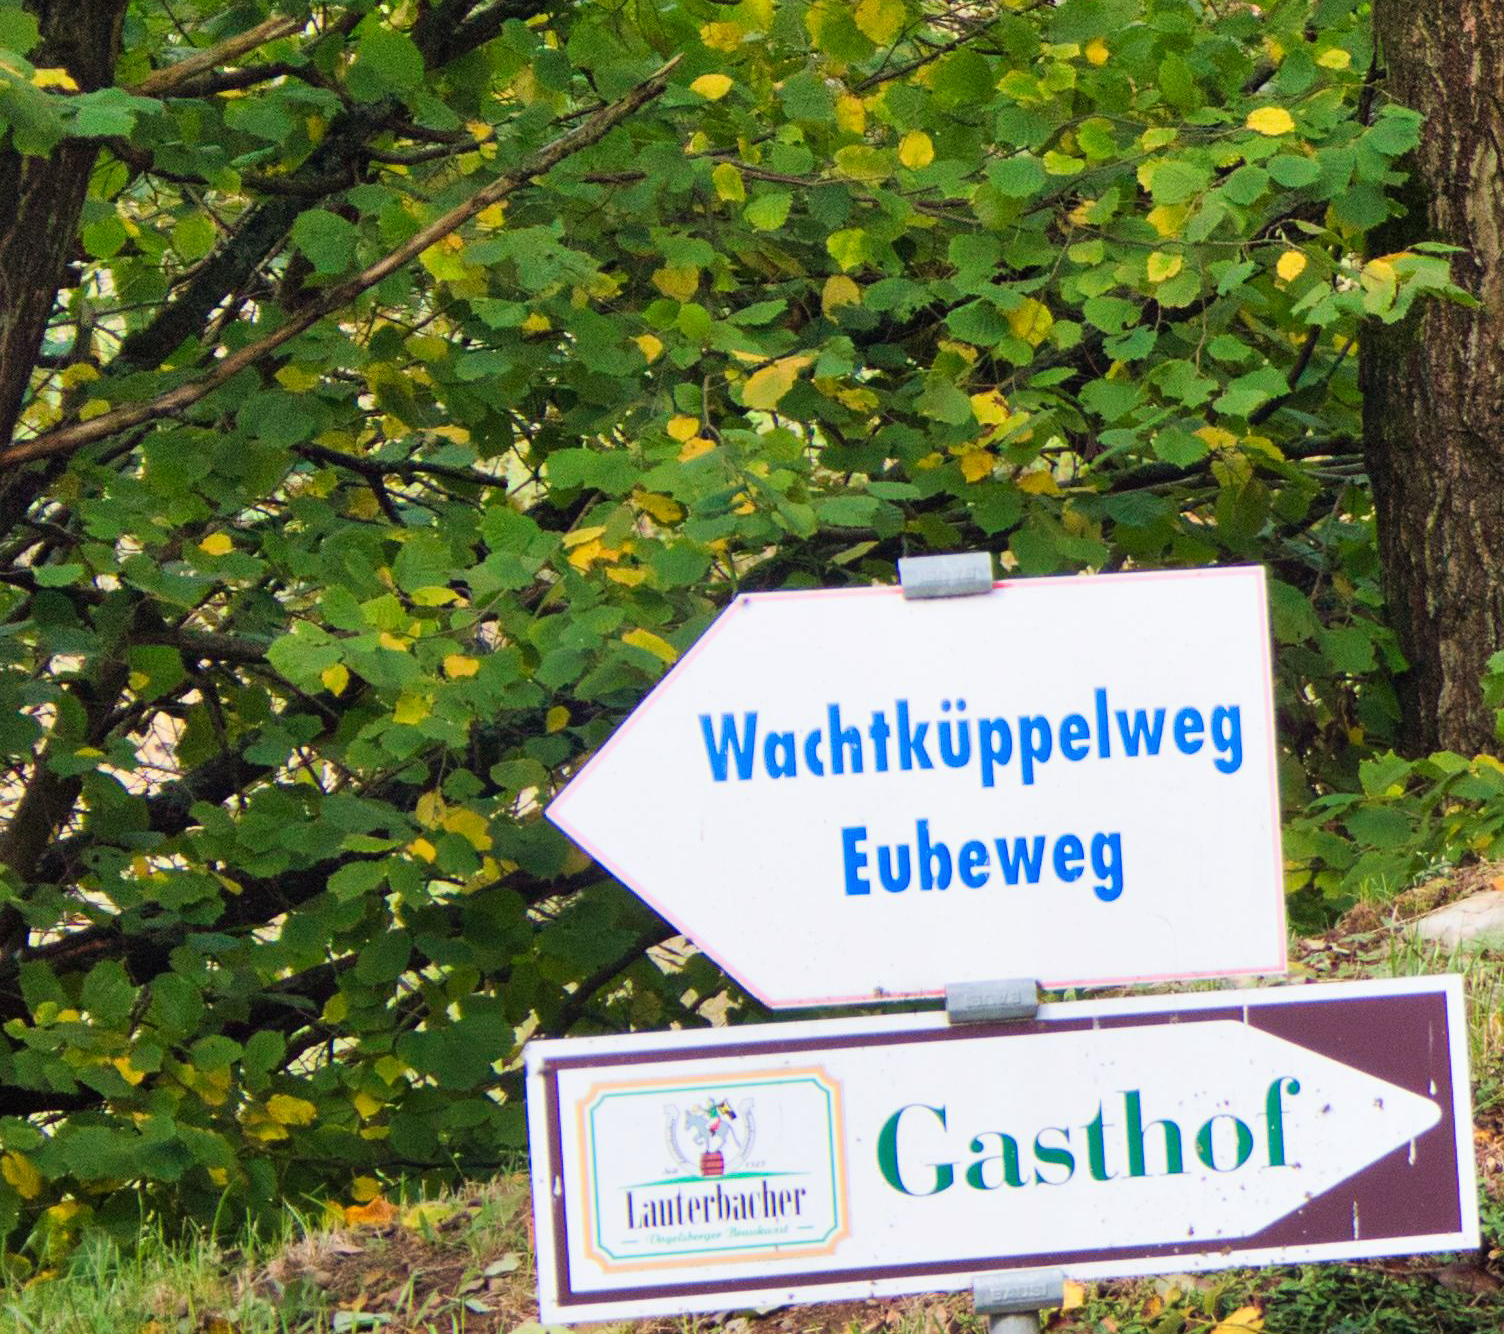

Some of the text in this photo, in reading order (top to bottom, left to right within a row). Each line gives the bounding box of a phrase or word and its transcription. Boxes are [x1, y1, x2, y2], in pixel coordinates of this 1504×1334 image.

[698, 687, 1243, 788] Wachtküppelweg
[841, 819, 1124, 902] Eubeweg
[876, 1077, 1301, 1198] Gasthof
[626, 1179, 807, 1229] Lauterbacher
